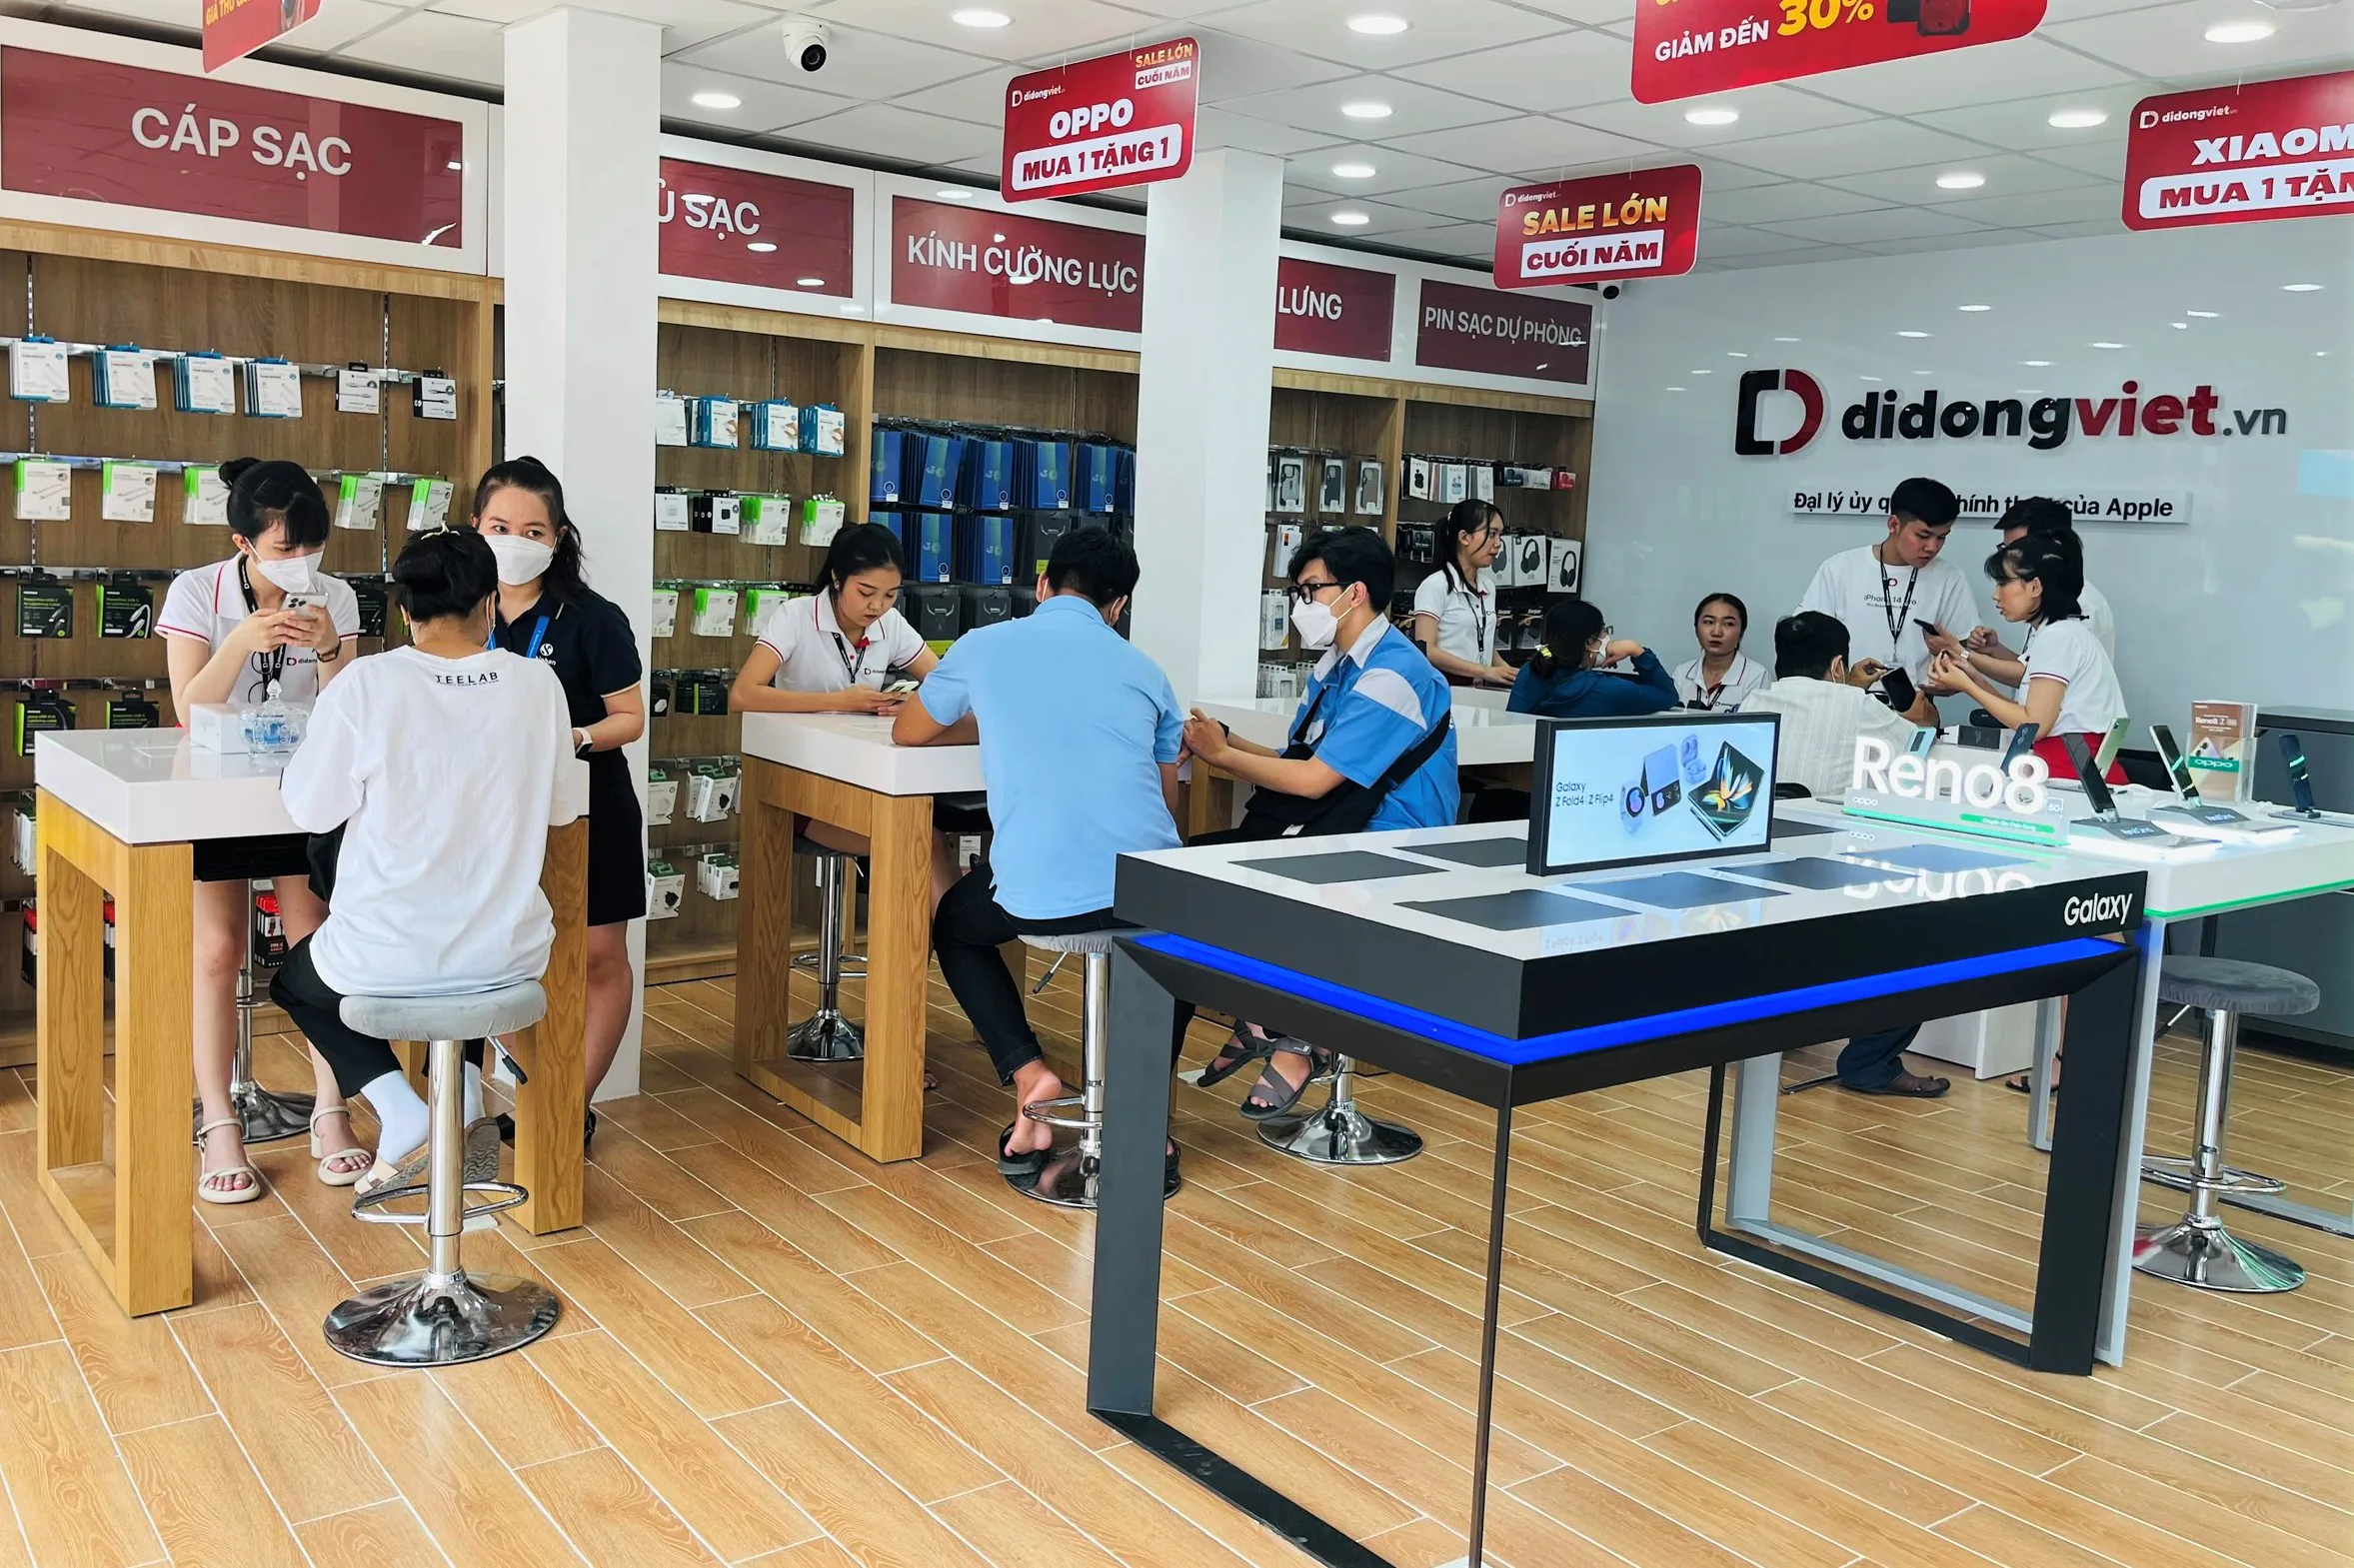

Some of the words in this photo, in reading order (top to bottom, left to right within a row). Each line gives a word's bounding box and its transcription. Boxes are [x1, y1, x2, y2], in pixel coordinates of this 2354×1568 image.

[1655, 30, 1713, 62] GIẢM
[1719, 15, 1769, 49] ĐẾN
[1776, 0, 1874, 36] 30%
[1136, 50, 1165, 68] SALE
[1168, 43, 1192, 62] LỚN
[1138, 70, 1163, 86] CUỐI
[1165, 66, 1189, 81] NĂM
[1050, 99, 1134, 139] OPPO
[131, 104, 240, 157] CÁP
[252, 125, 353, 181] SẠC
[1023, 155, 1072, 182] MUA
[1079, 152, 1086, 172] 1
[1092, 142, 1154, 174] TẶNG
[1161, 137, 1169, 158] 1
[2159, 183, 2249, 209] MUA
[2262, 178, 2274, 200] 1
[685, 197, 760, 240] SẠC
[1522, 204, 1595, 236] SALE
[1602, 193, 1667, 227] LỚN
[908, 230, 978, 272] KÍNH
[984, 245, 1083, 286] CƯỜNG
[1088, 261, 1138, 297] LỰC
[1526, 241, 1587, 270] CUỐI
[1593, 240, 1658, 265] NĂM
[1278, 285, 1342, 320] LƯNG
[1424, 306, 1454, 331] PIN
[1457, 311, 1492, 340] SẠC
[1496, 316, 1521, 344] DỰ
[1523, 318, 1582, 347] PHÒNG
[1841, 380, 2287, 450] didongviet.vn
[1794, 492, 1822, 513] Đại
[1827, 491, 1844, 513] lý
[1849, 491, 1873, 514] ủy
[1956, 494, 1999, 513] hính
[2106, 498, 2173, 521] Apple
[434, 672, 498, 685] TEELAB
[1852, 736, 2049, 814] Reno8
[2194, 758, 2233, 769] oppo
[1555, 796, 1561, 806] Z
[1562, 794, 1583, 806] Fold4
[1588, 793, 1593, 804] Z
[1556, 782, 1586, 793] Galaxy
[1851, 795, 1879, 807] oppo
[2063, 892, 2133, 925] Galaxy
